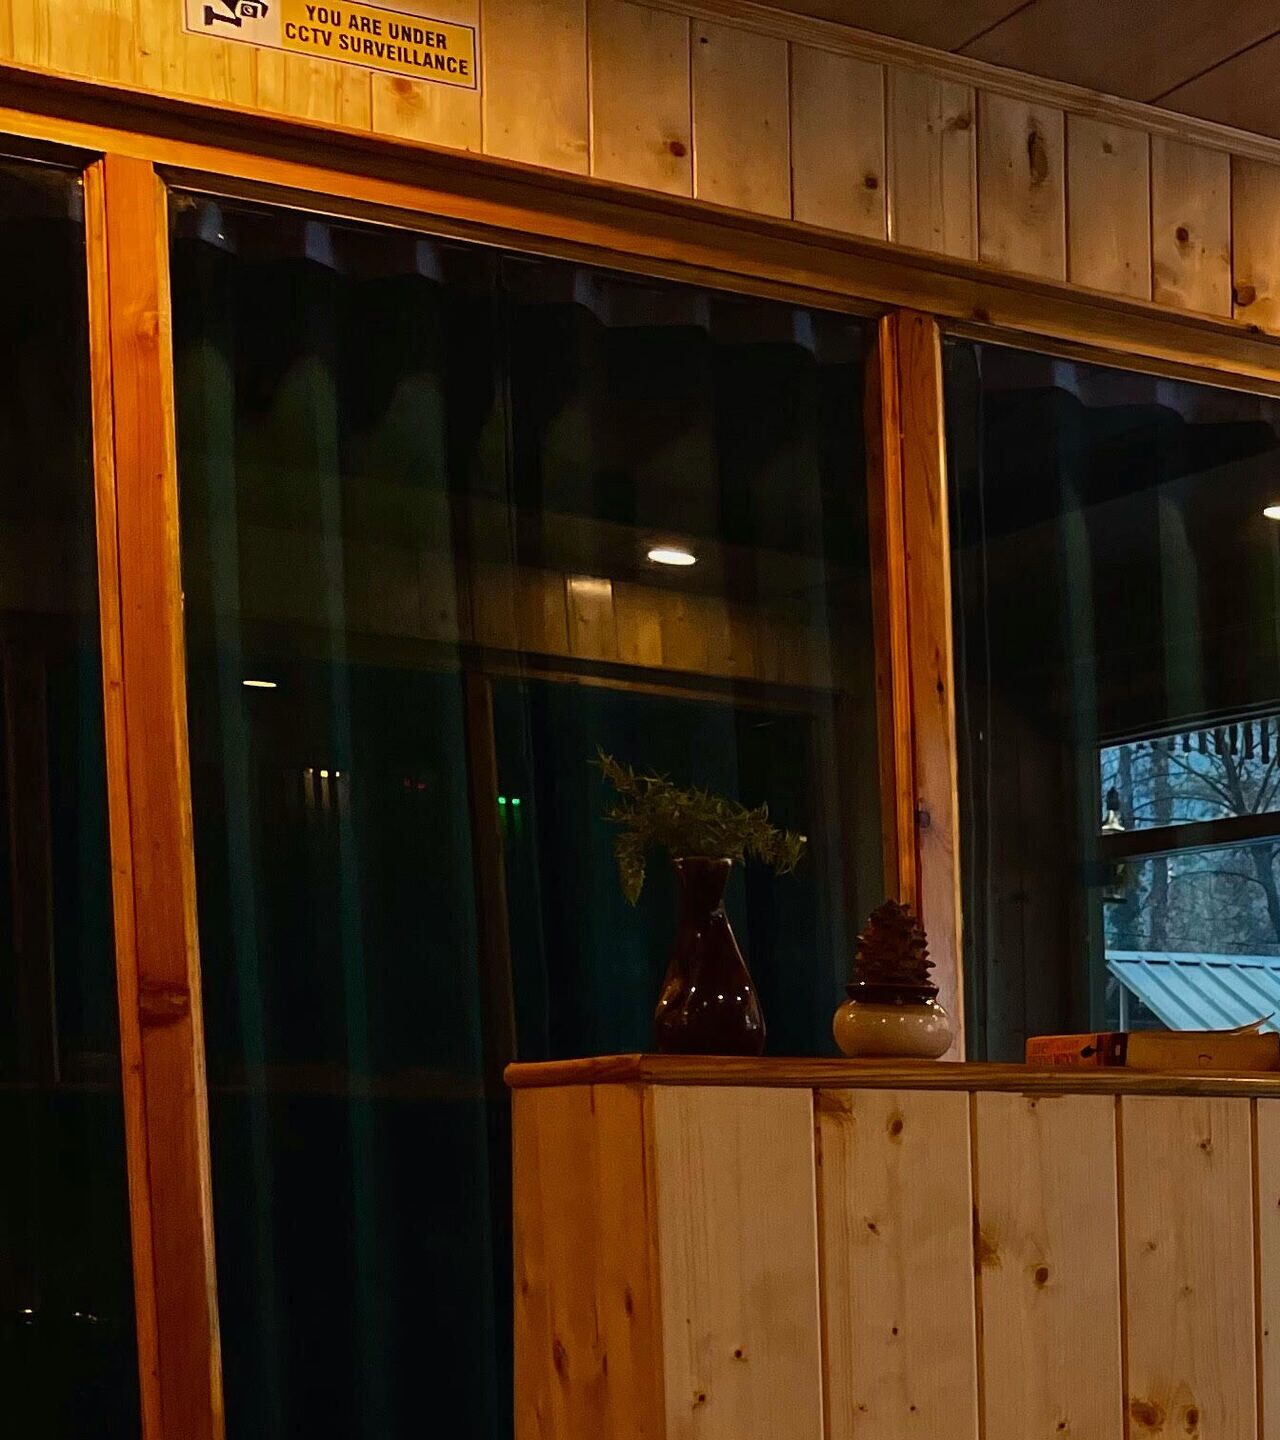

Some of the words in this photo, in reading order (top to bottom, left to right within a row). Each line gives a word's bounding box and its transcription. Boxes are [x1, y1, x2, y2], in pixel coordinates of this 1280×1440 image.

[285, 22, 332, 46] CCTV
[339, 33, 469, 76] SURVEILLANCE
[305, 4, 341, 27] YOU
[348, 14, 382, 36] ARE
[388, 22, 447, 50] UNDER
